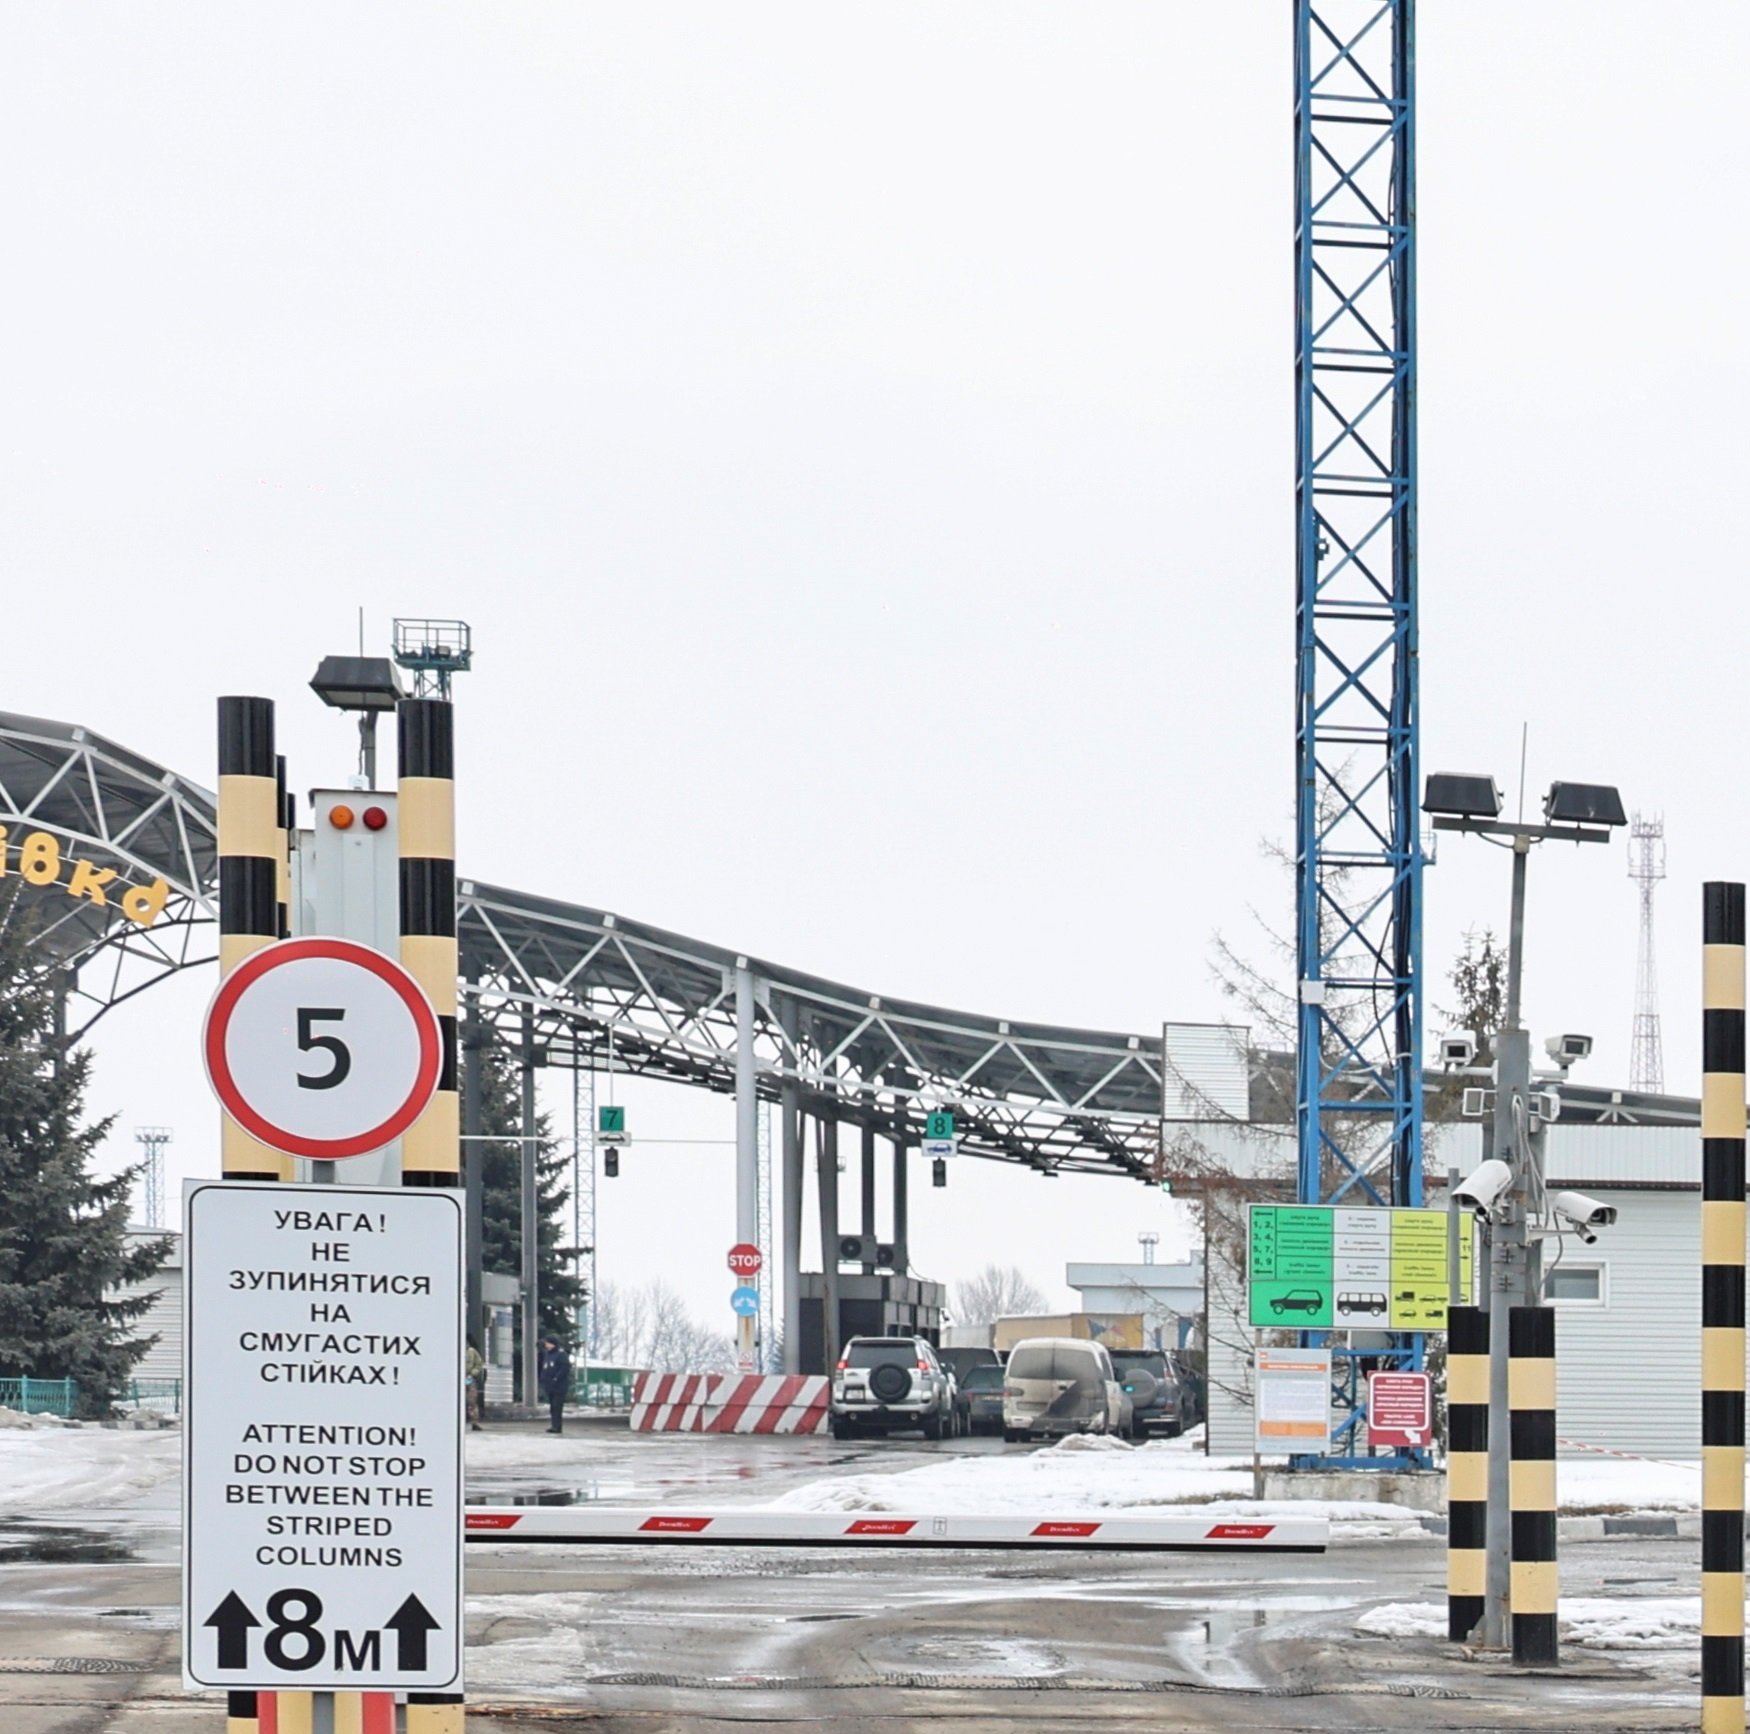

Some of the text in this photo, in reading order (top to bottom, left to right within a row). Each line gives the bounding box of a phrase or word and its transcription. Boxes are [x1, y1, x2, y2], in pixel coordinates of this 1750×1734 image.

[296, 1007, 352, 1091] 5
[606, 1110, 618, 1128] 7
[934, 1117, 946, 1135] 8
[311, 1242, 350, 1263] НЕ
[729, 1254, 761, 1267] STOP
[229, 1270, 430, 1296] ЗУПИНЯТИСЯ
[310, 1303, 352, 1324] НА
[239, 1331, 421, 1356] СМУГАСТИХ
[242, 1423, 416, 1447] ATTENTION!
[234, 1454, 426, 1477] DO NOT STOP
[225, 1484, 433, 1508] BETWEEN THE
[266, 1515, 392, 1537] STRIPED
[255, 1545, 403, 1568] COLUMNS
